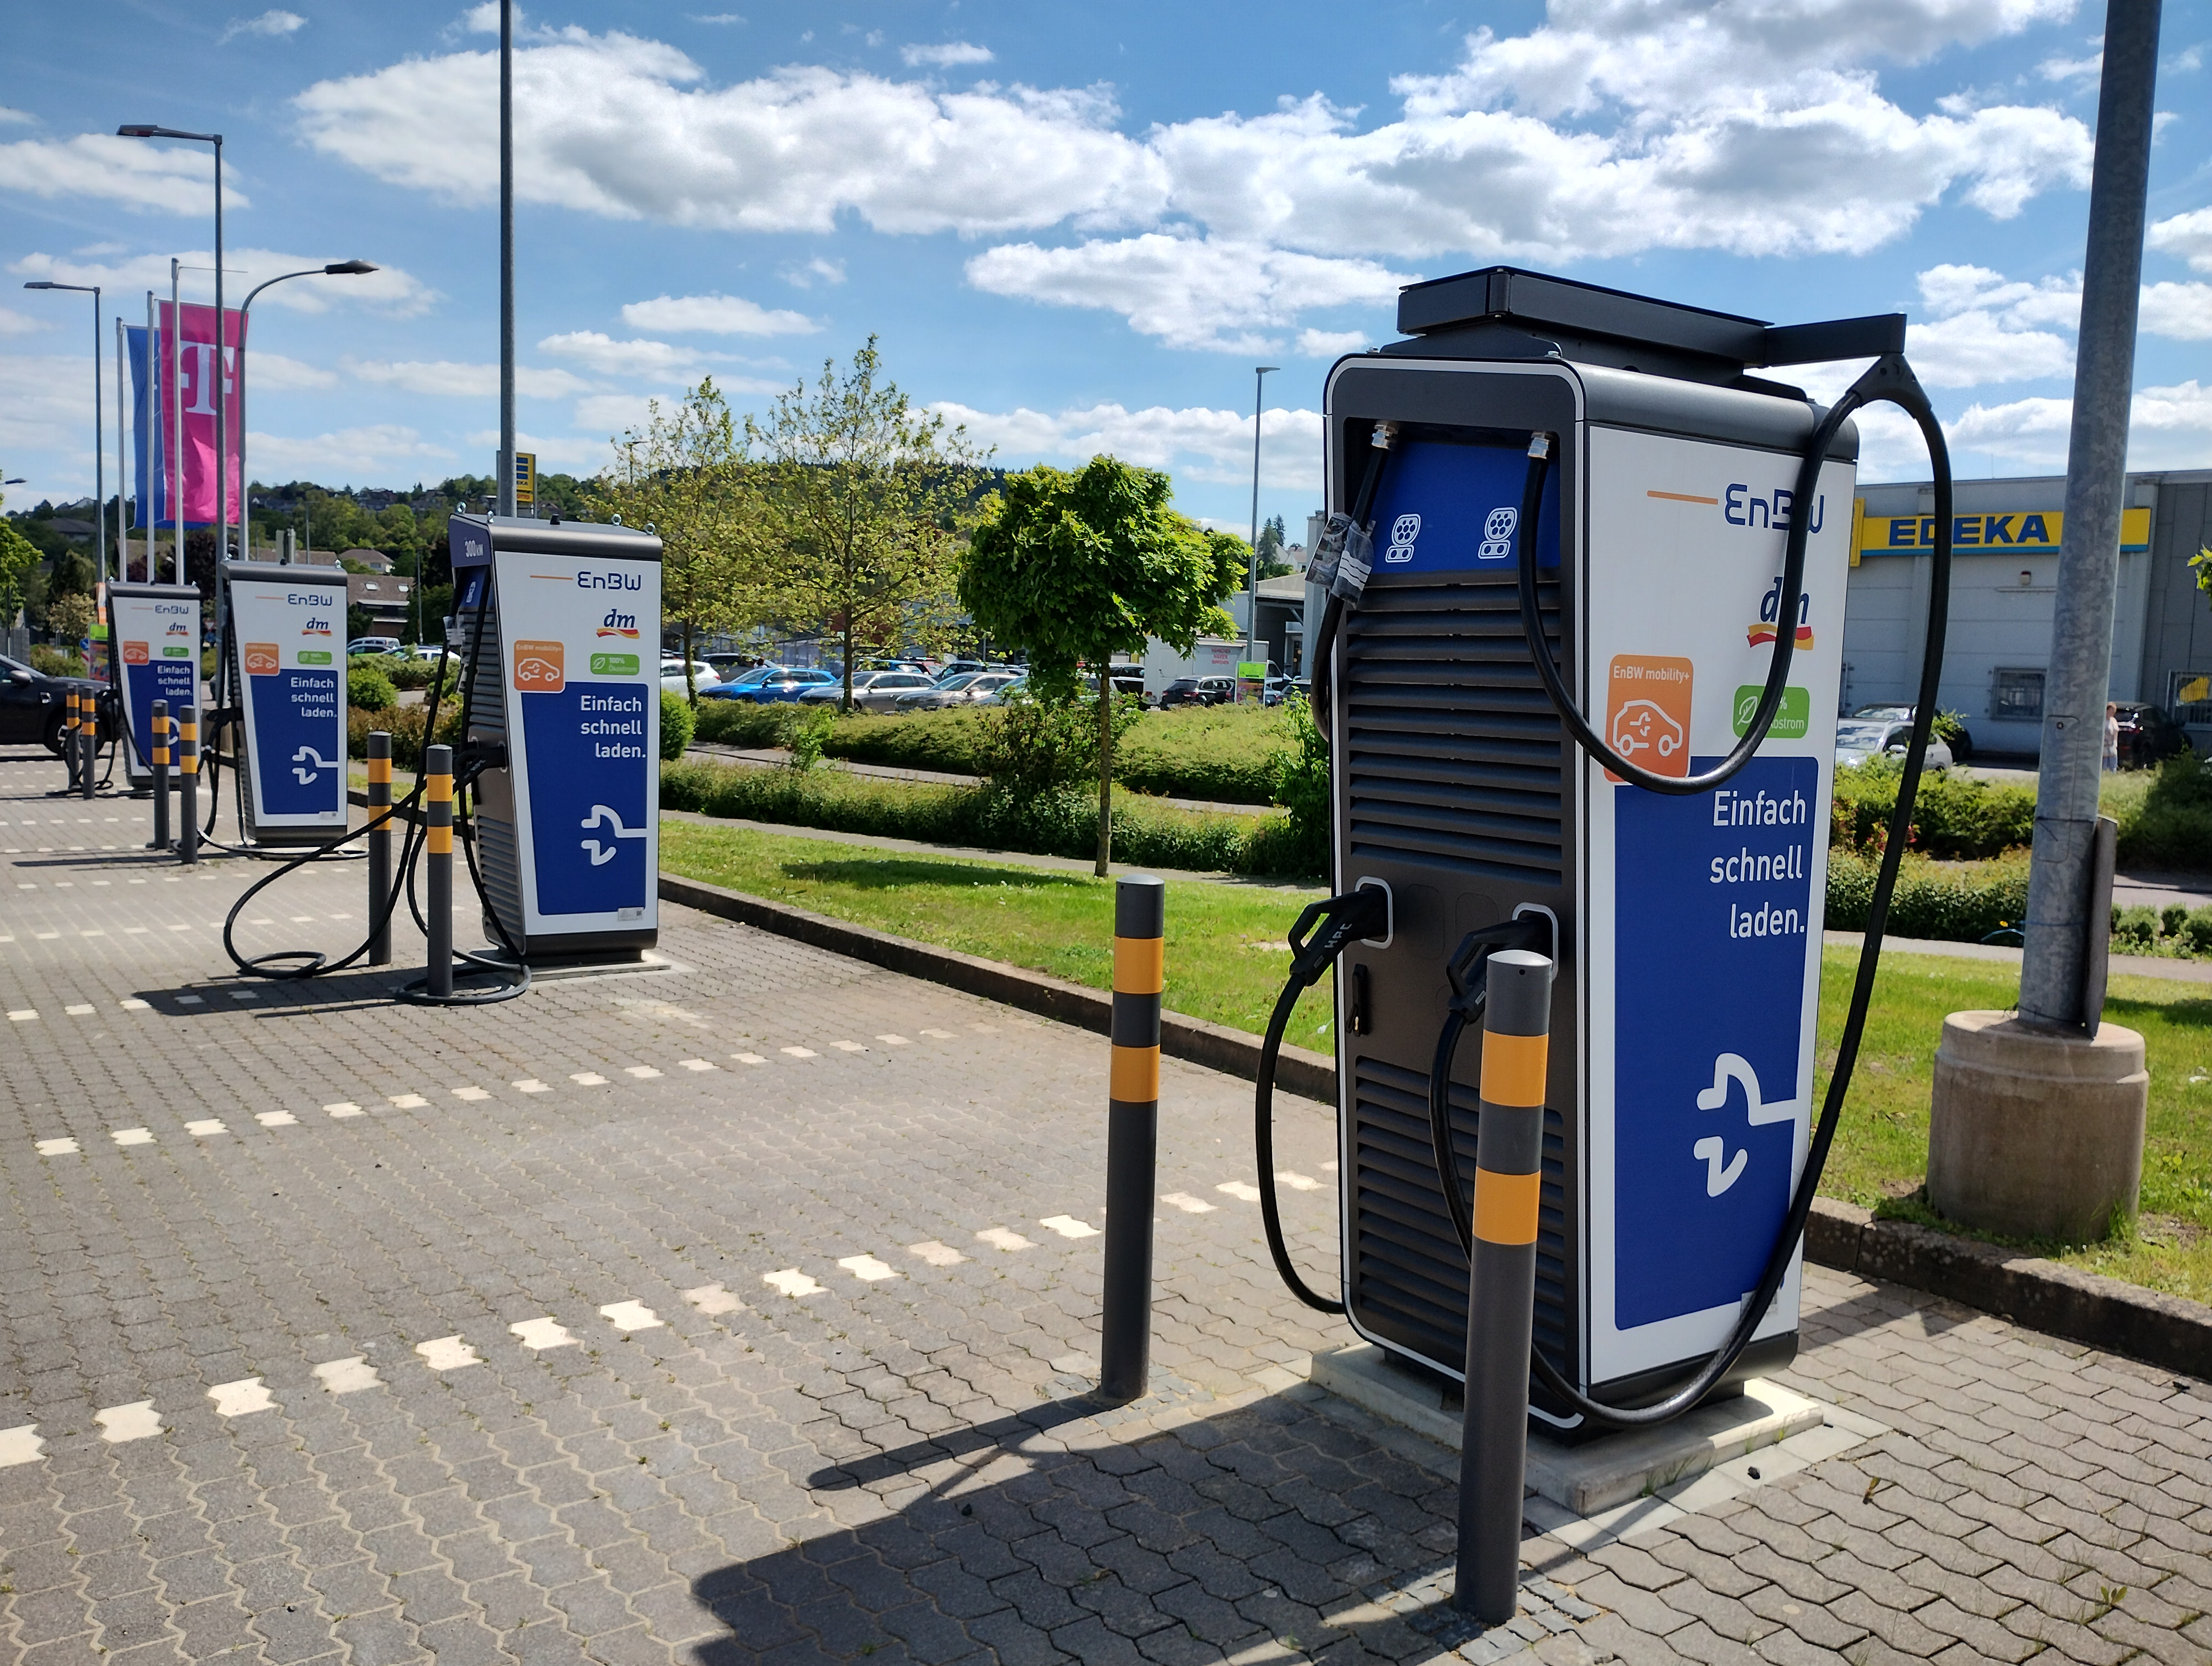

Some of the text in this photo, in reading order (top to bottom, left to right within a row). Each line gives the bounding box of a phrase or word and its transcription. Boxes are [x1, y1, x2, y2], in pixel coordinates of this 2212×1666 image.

[1889, 515, 2050, 546] EDEKA
[577, 571, 641, 591] EnBW
[288, 594, 332, 606] EnBW
[155, 605, 189, 614] EnBW
[306, 617, 329, 630] dm
[603, 608, 635, 629] dm
[169, 622, 187, 631] dm
[157, 665, 190, 675] Einfach
[1613, 665, 1690, 684] EnBW mobility+
[158, 676, 191, 685] schnell
[291, 677, 334, 689] Einfach
[165, 687, 193, 696] laden.
[291, 692, 335, 703] schnell
[581, 695, 642, 712] Einfach
[301, 706, 338, 718] laden.
[581, 719, 642, 735] schnell
[1771, 716, 1804, 729] ostrom
[595, 742, 646, 758] laden.
[1713, 790, 1806, 826] Einfach
[1709, 844, 1803, 883] schnell
[1729, 901, 1805, 939] laden.
[1323, 923, 1353, 949] HPC
